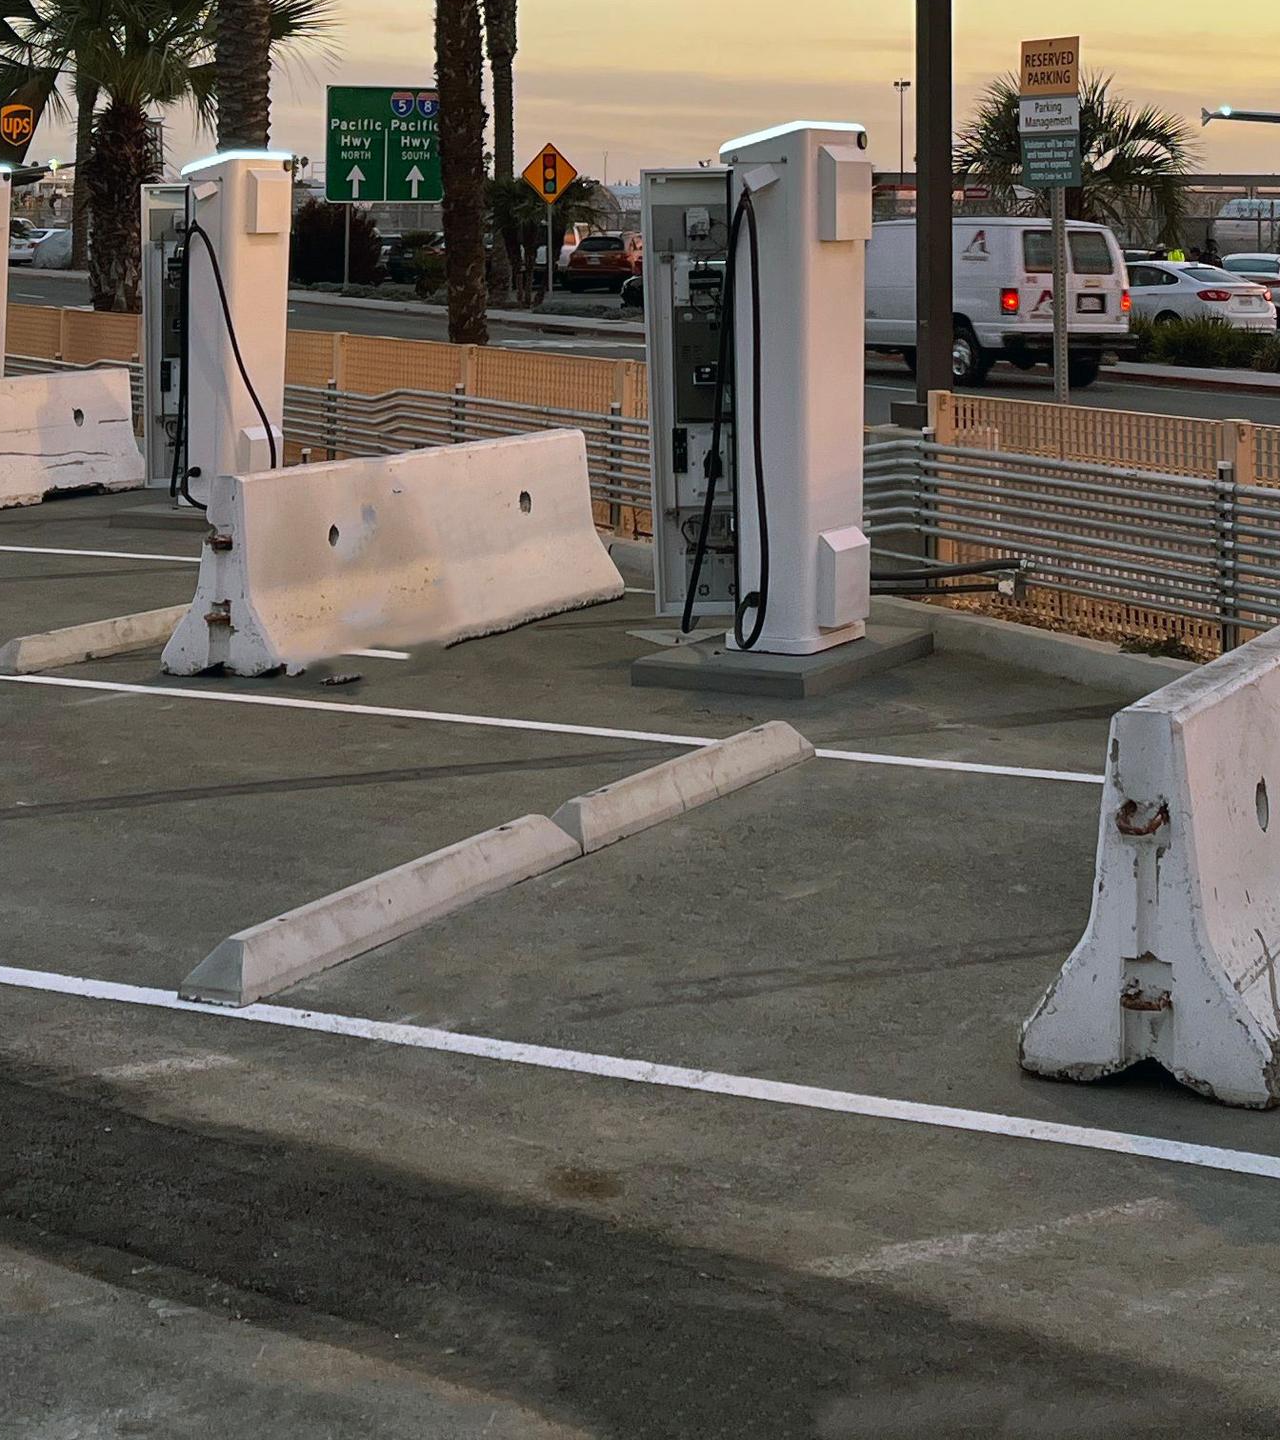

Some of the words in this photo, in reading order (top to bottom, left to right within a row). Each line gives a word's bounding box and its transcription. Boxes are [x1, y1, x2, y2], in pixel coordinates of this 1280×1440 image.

[1024, 50, 1074, 68] RESERVED
[1027, 69, 1071, 86] PARKING
[398, 99, 407, 112] 5
[423, 100, 432, 113] 8
[1034, 102, 1062, 115] Parking
[3, 117, 31, 140] ups
[330, 118, 383, 131] Pacific
[390, 119, 439, 132] Pacific
[1024, 116, 1073, 130] Management
[340, 135, 372, 149] Hwy
[401, 135, 431, 150] Hwy
[340, 150, 371, 160] NORTH
[401, 150, 431, 160] SOUTH
